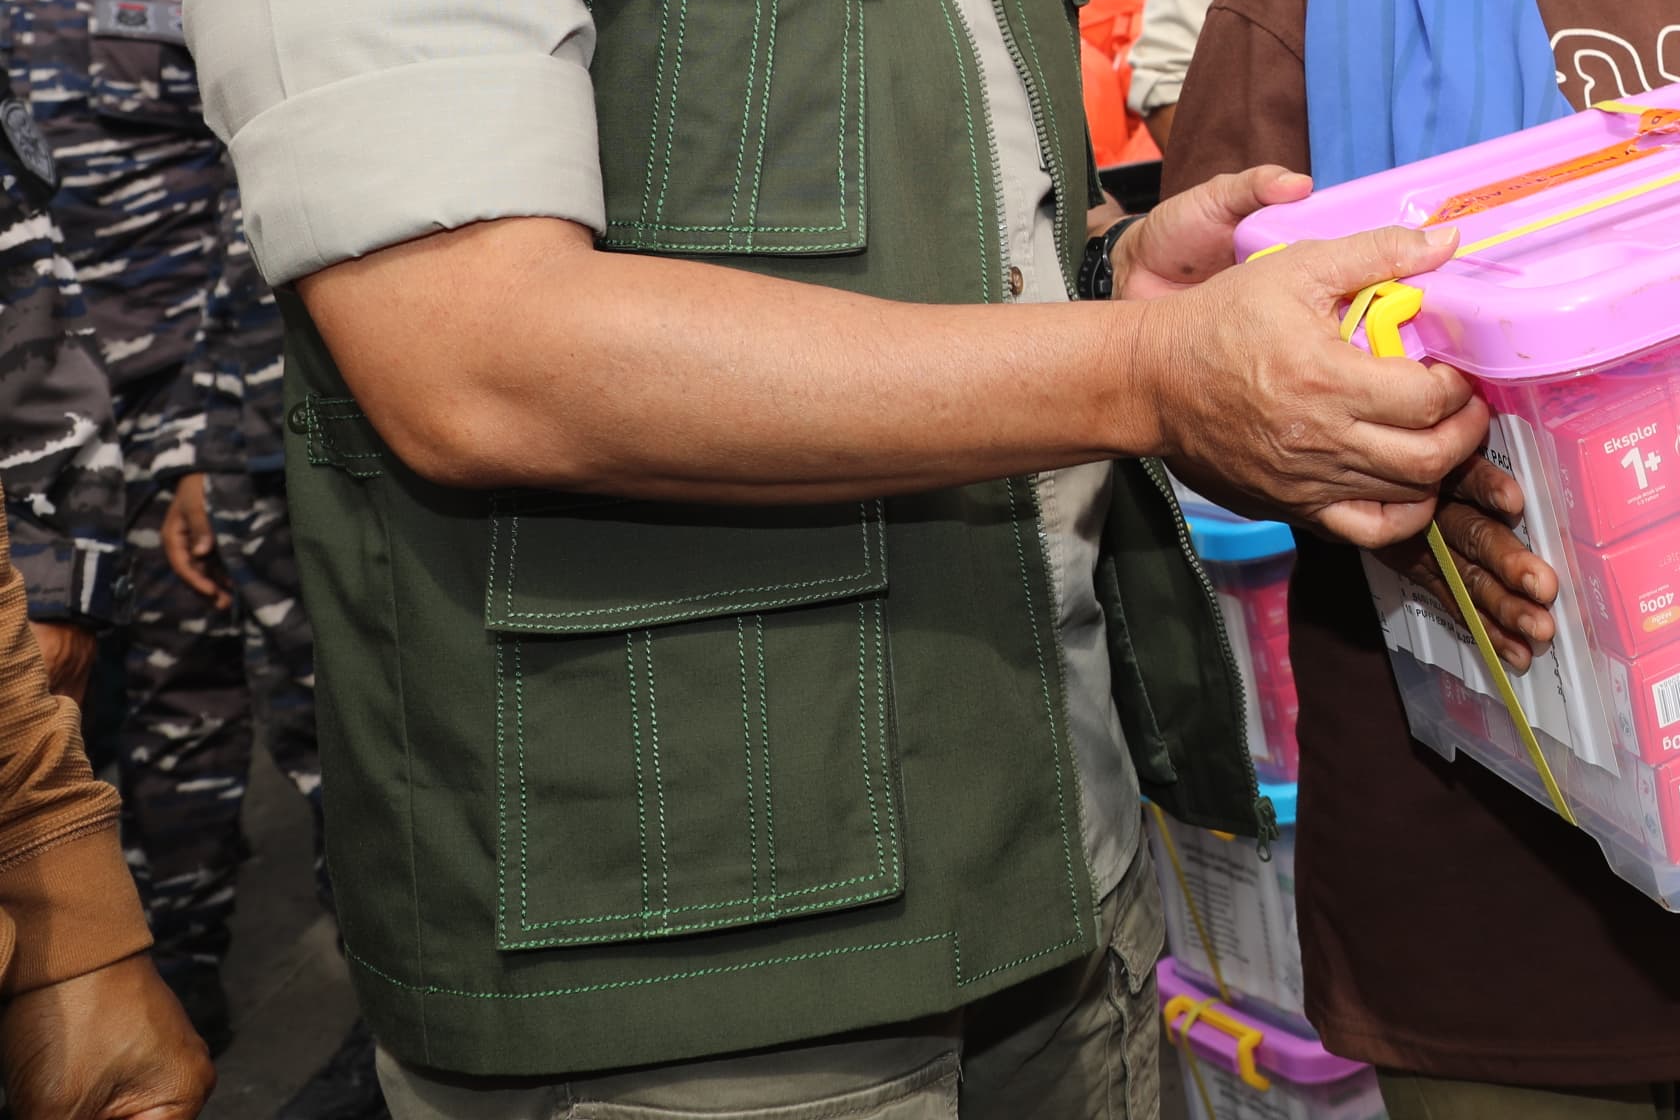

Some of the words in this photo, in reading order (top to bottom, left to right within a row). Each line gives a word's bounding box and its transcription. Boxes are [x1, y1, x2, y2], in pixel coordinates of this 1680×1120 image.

[1603, 422, 1658, 454] Eksplor
[1620, 446, 1662, 490] 1+
[1640, 591, 1675, 614] 400g
